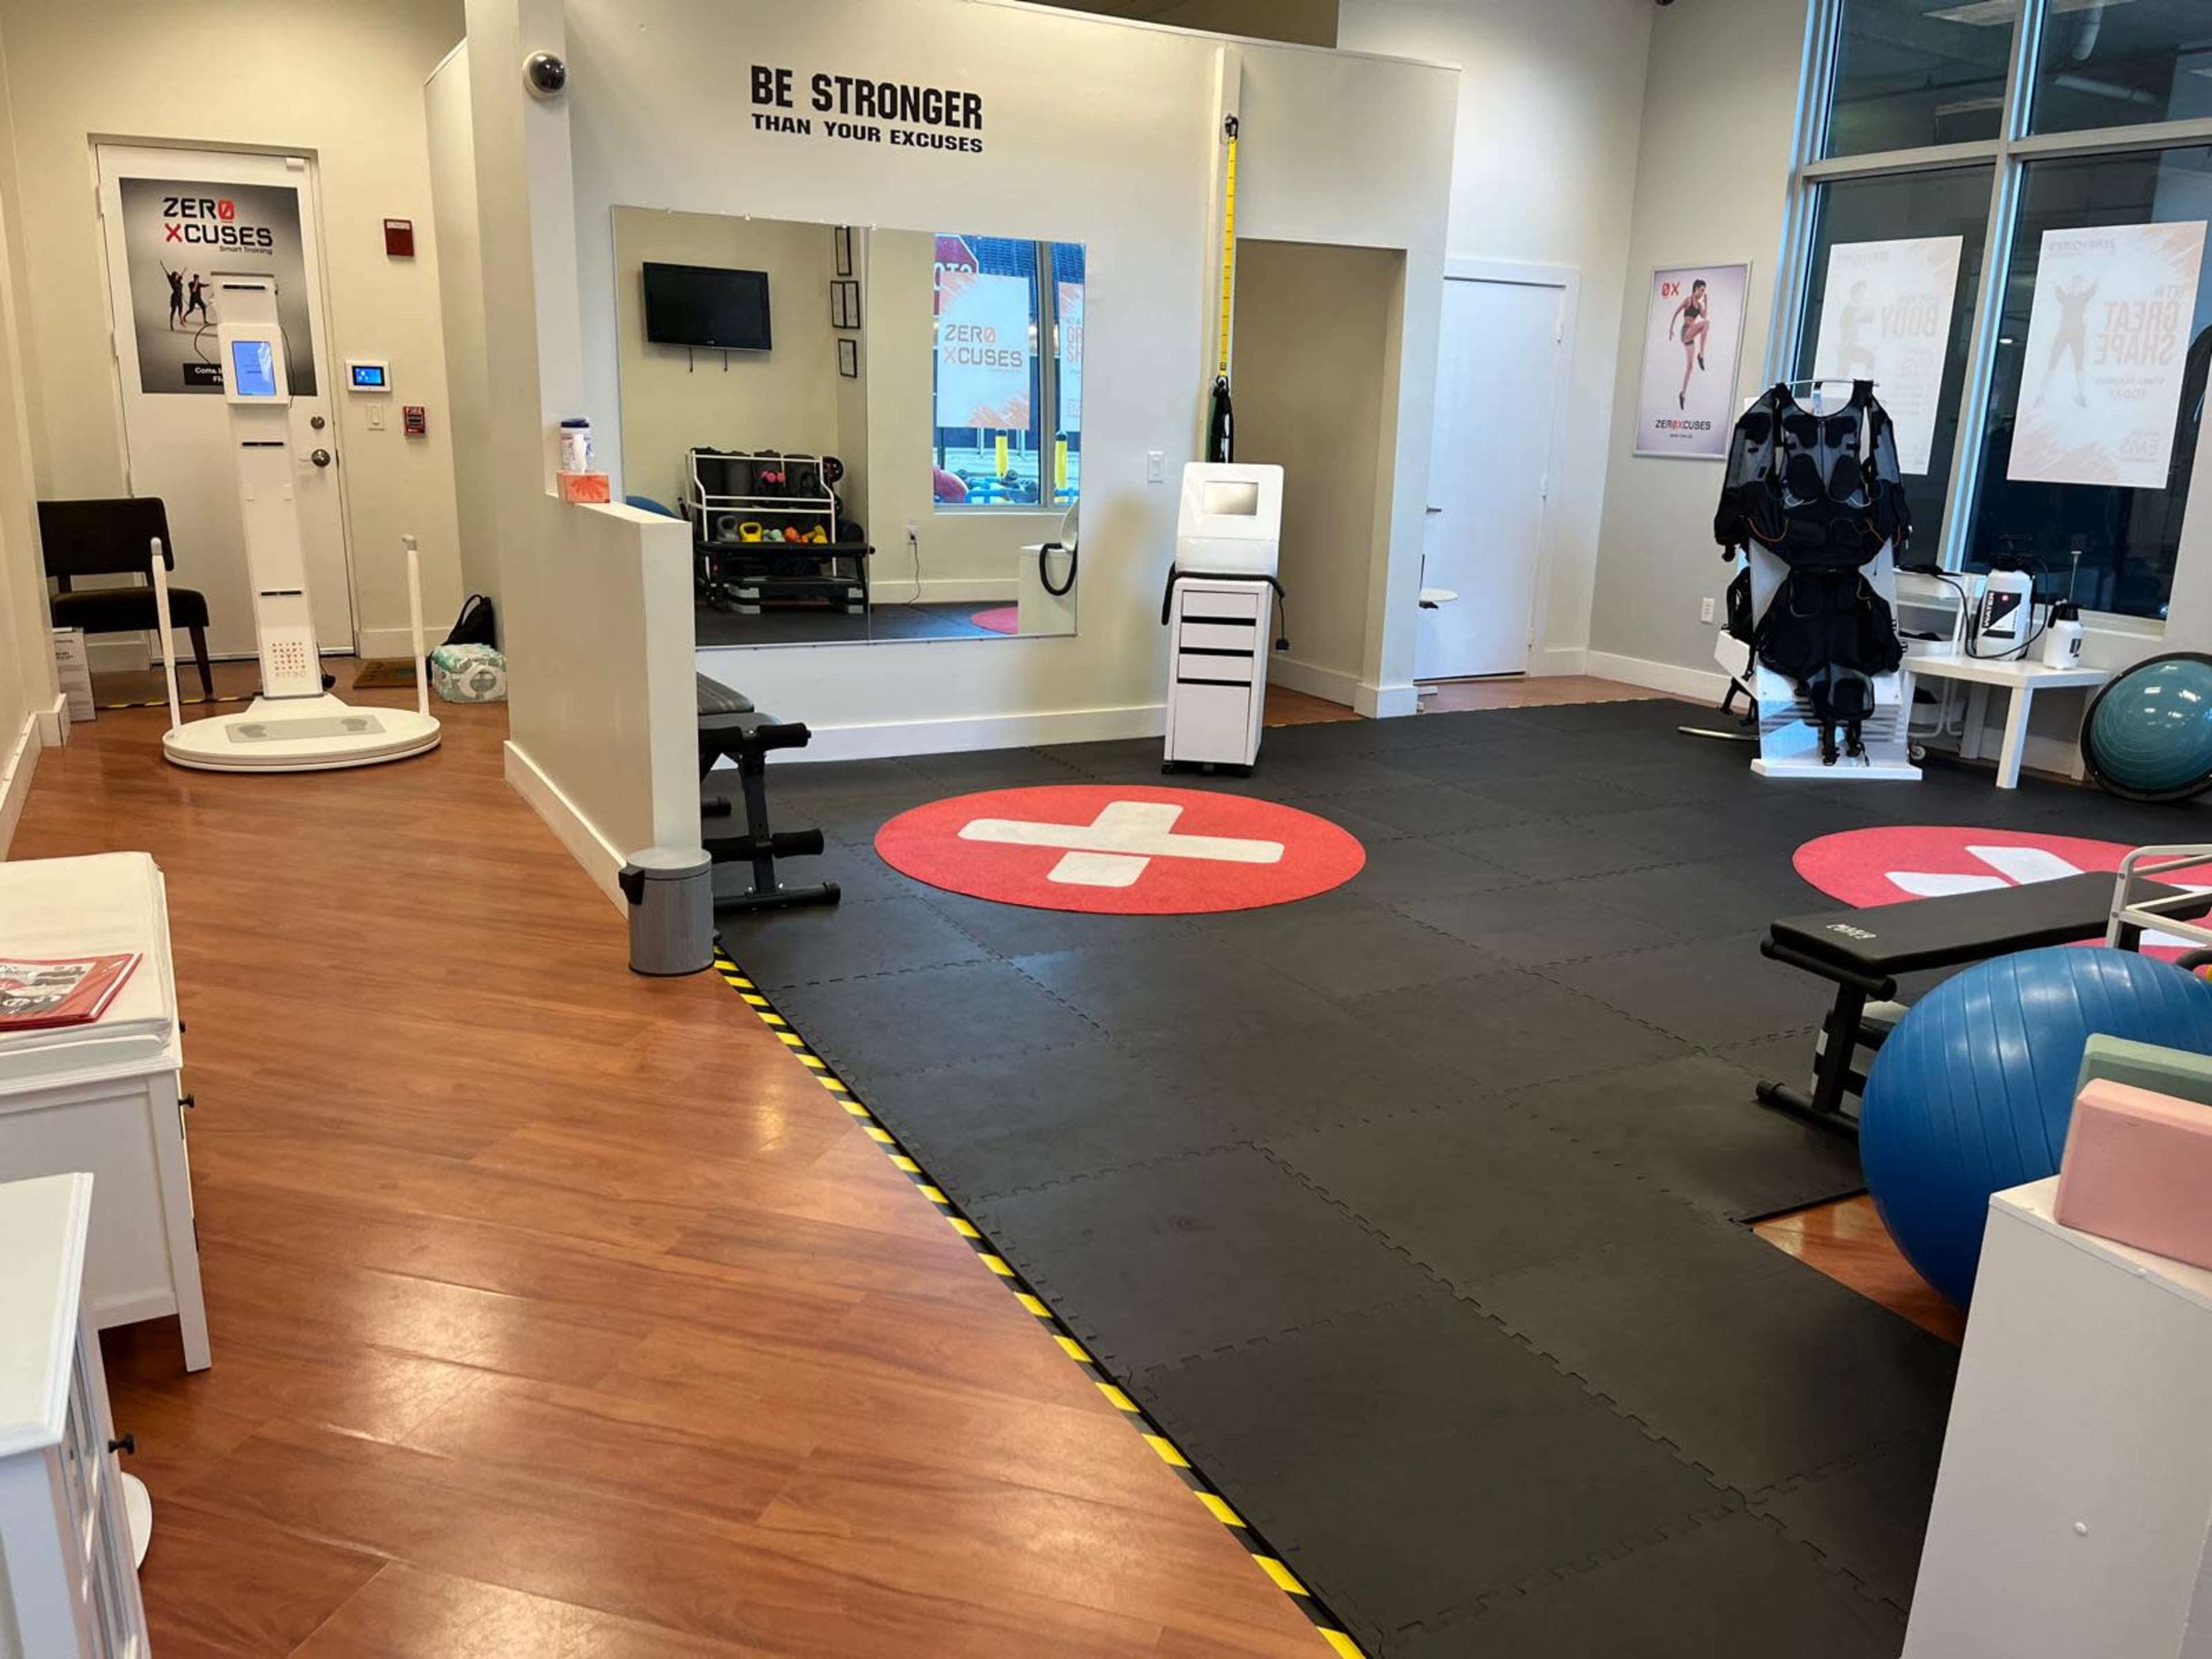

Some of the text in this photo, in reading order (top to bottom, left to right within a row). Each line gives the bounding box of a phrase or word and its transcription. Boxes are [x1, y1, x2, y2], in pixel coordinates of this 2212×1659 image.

[752, 65, 983, 130] BE STRONGER
[752, 113, 983, 153] THAN YOUR EXCUSES
[164, 223, 273, 247] XCUSES
[244, 247, 273, 255] Training
[944, 347, 1022, 368] XCUSES
[1983, 592, 1995, 628] WATER
